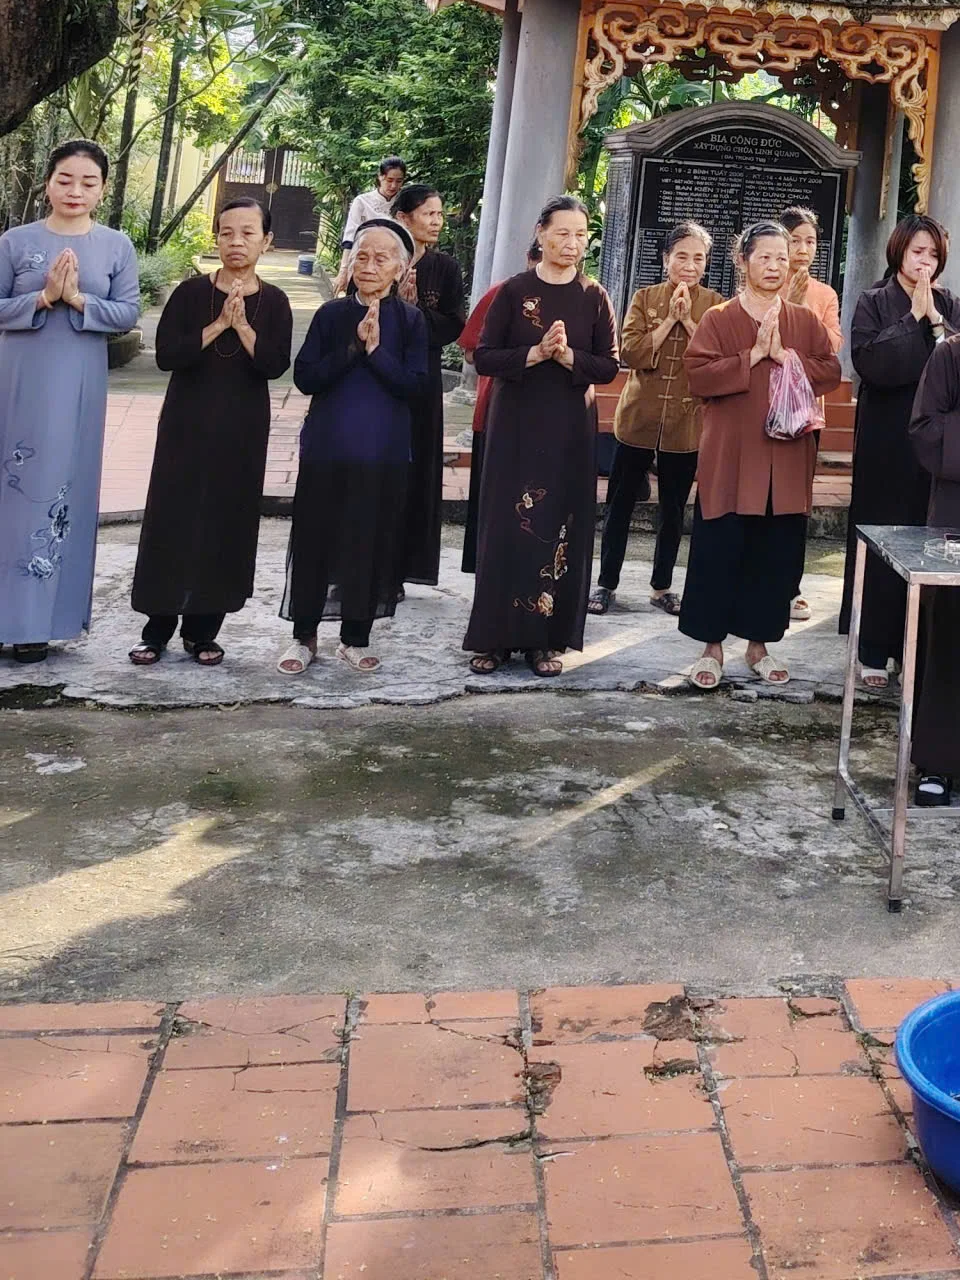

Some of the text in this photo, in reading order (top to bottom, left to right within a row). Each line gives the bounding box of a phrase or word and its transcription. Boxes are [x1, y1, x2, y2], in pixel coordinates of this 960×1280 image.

[730, 135, 758, 146] CÔNG
[760, 138, 782, 148] ĐỨC
[733, 145, 753, 154] CHÙA
[755, 148, 773, 156] LINH
[774, 150, 800, 158] QUANG
